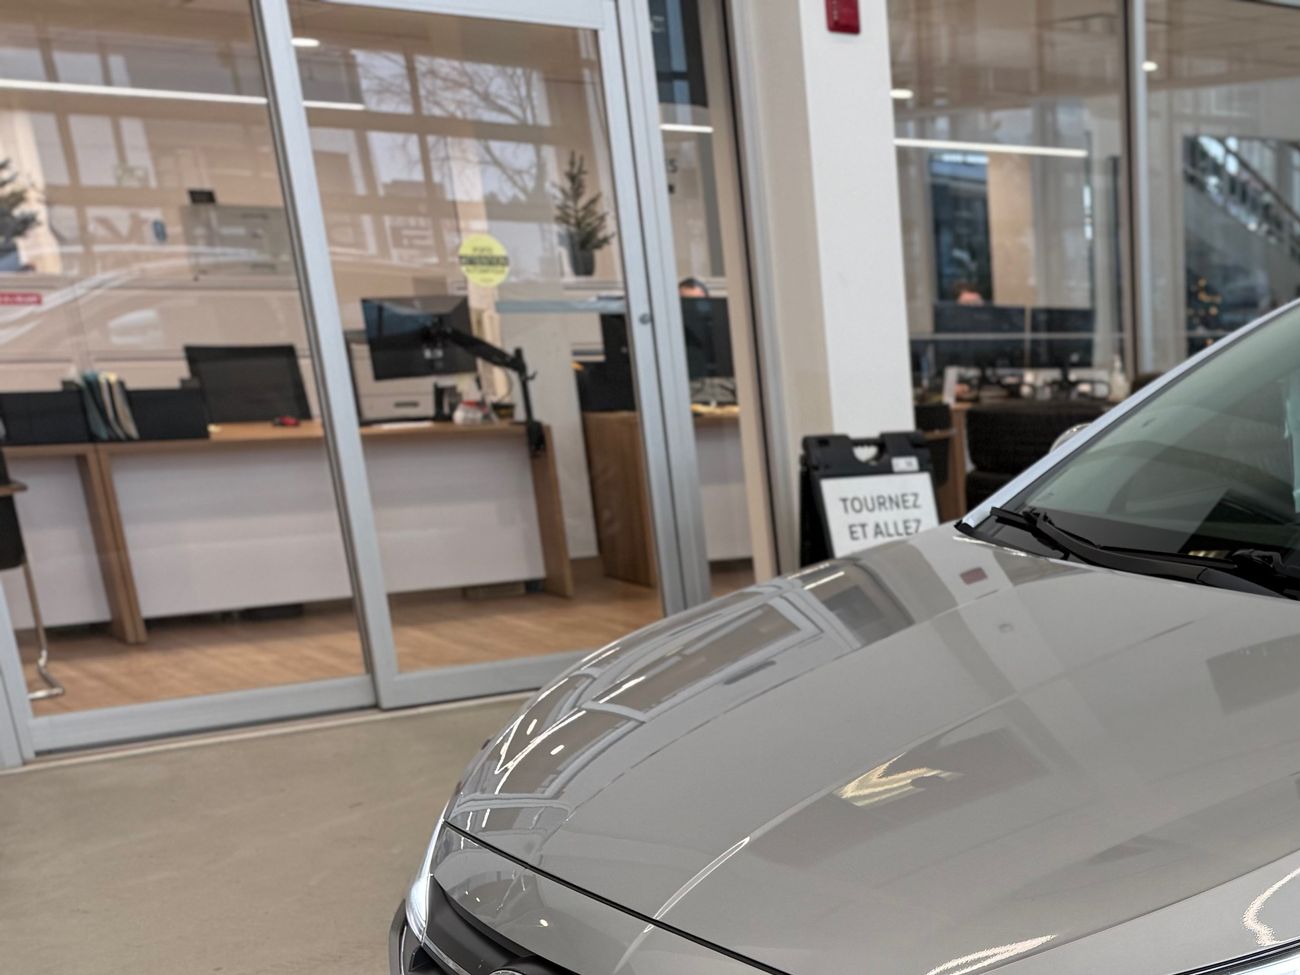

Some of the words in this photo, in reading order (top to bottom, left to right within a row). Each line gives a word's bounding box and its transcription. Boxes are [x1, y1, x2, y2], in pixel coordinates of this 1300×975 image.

[840, 493, 921, 514] TOURNEZ
[849, 523, 868, 541] ET
[873, 518, 922, 539] ALLEZ
